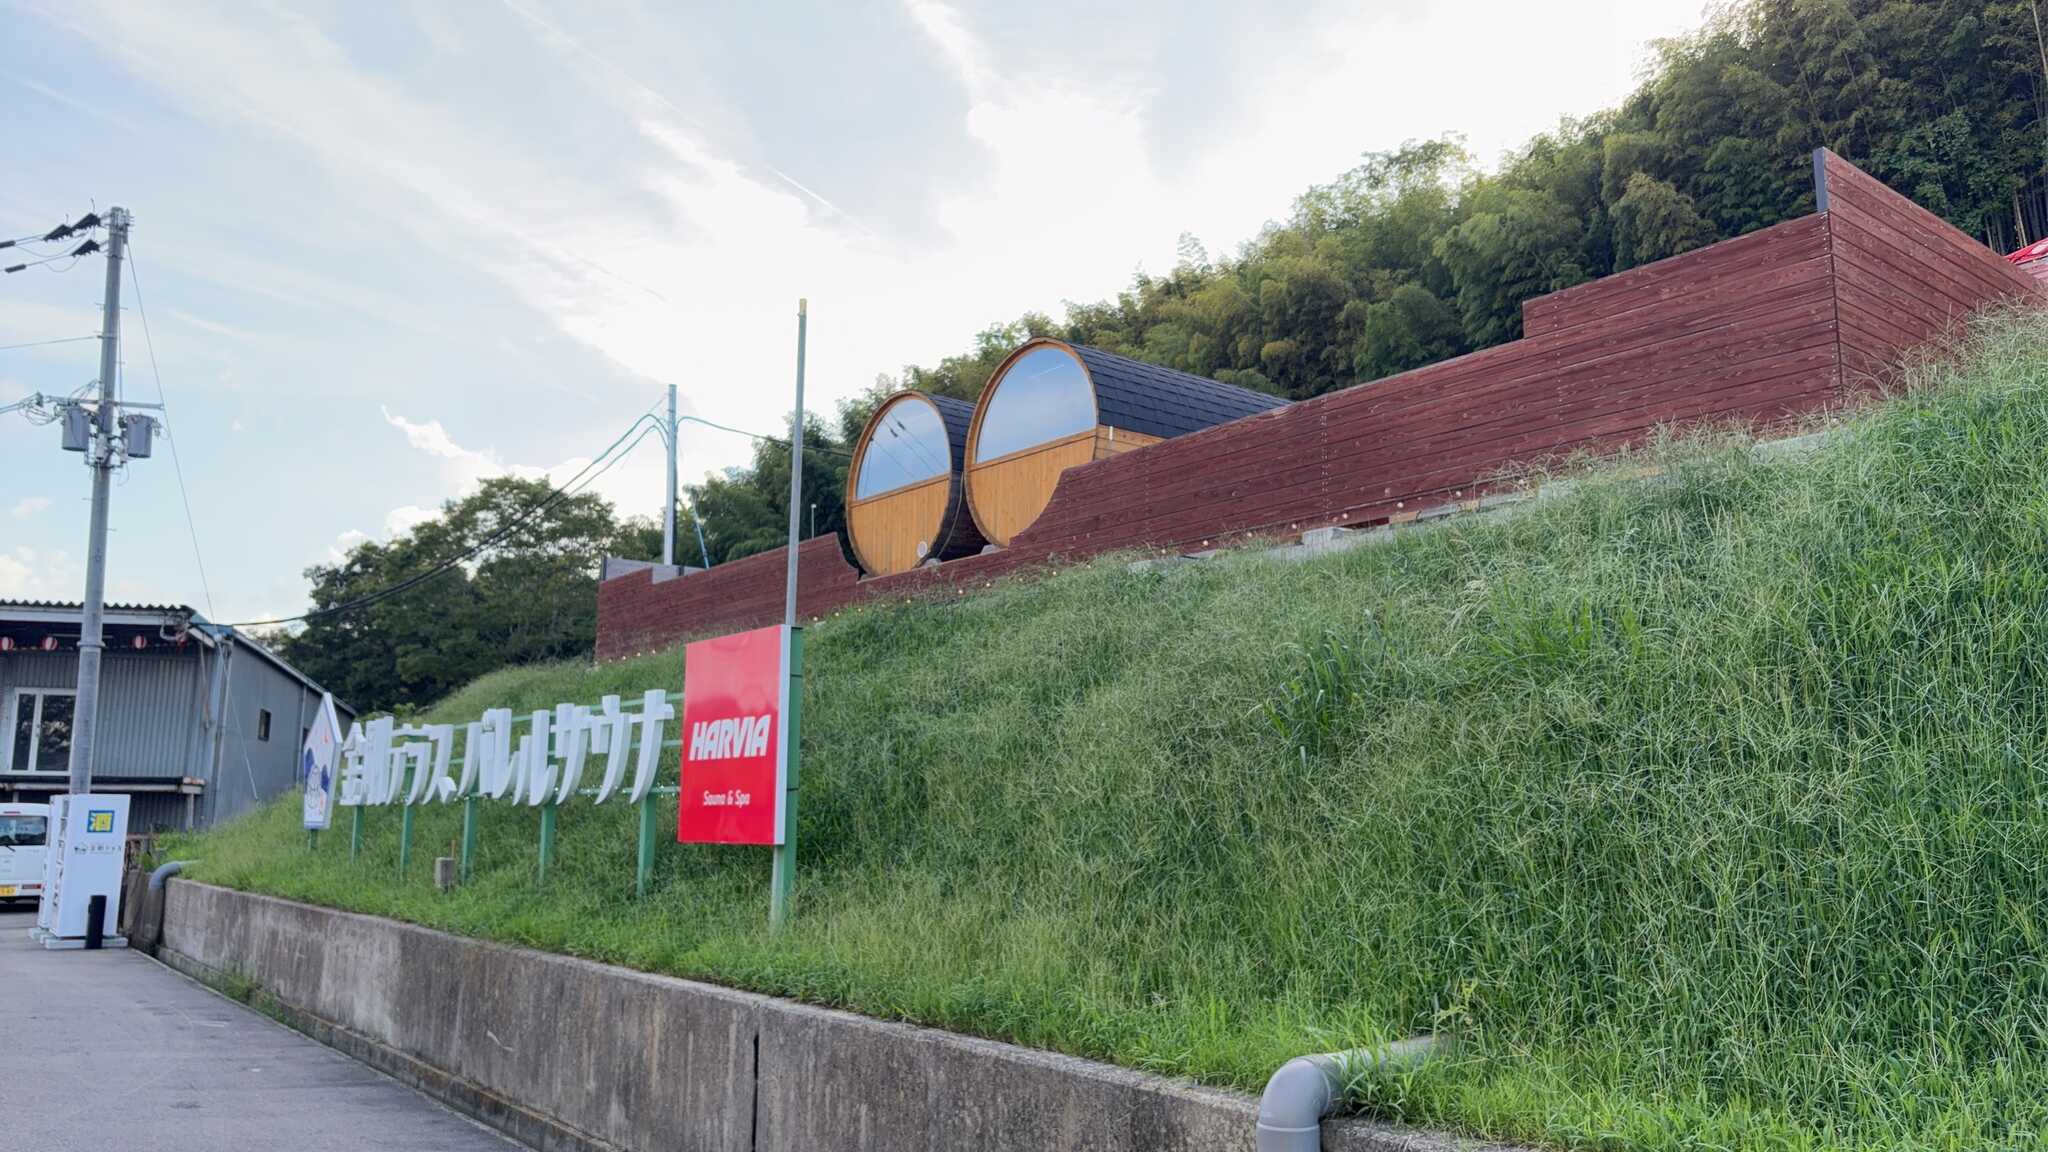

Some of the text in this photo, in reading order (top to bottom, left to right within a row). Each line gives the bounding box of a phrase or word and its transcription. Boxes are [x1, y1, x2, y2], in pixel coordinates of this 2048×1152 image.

[689, 714, 771, 761] HARVIA
[703, 789, 750, 808] Sauna & Spa
